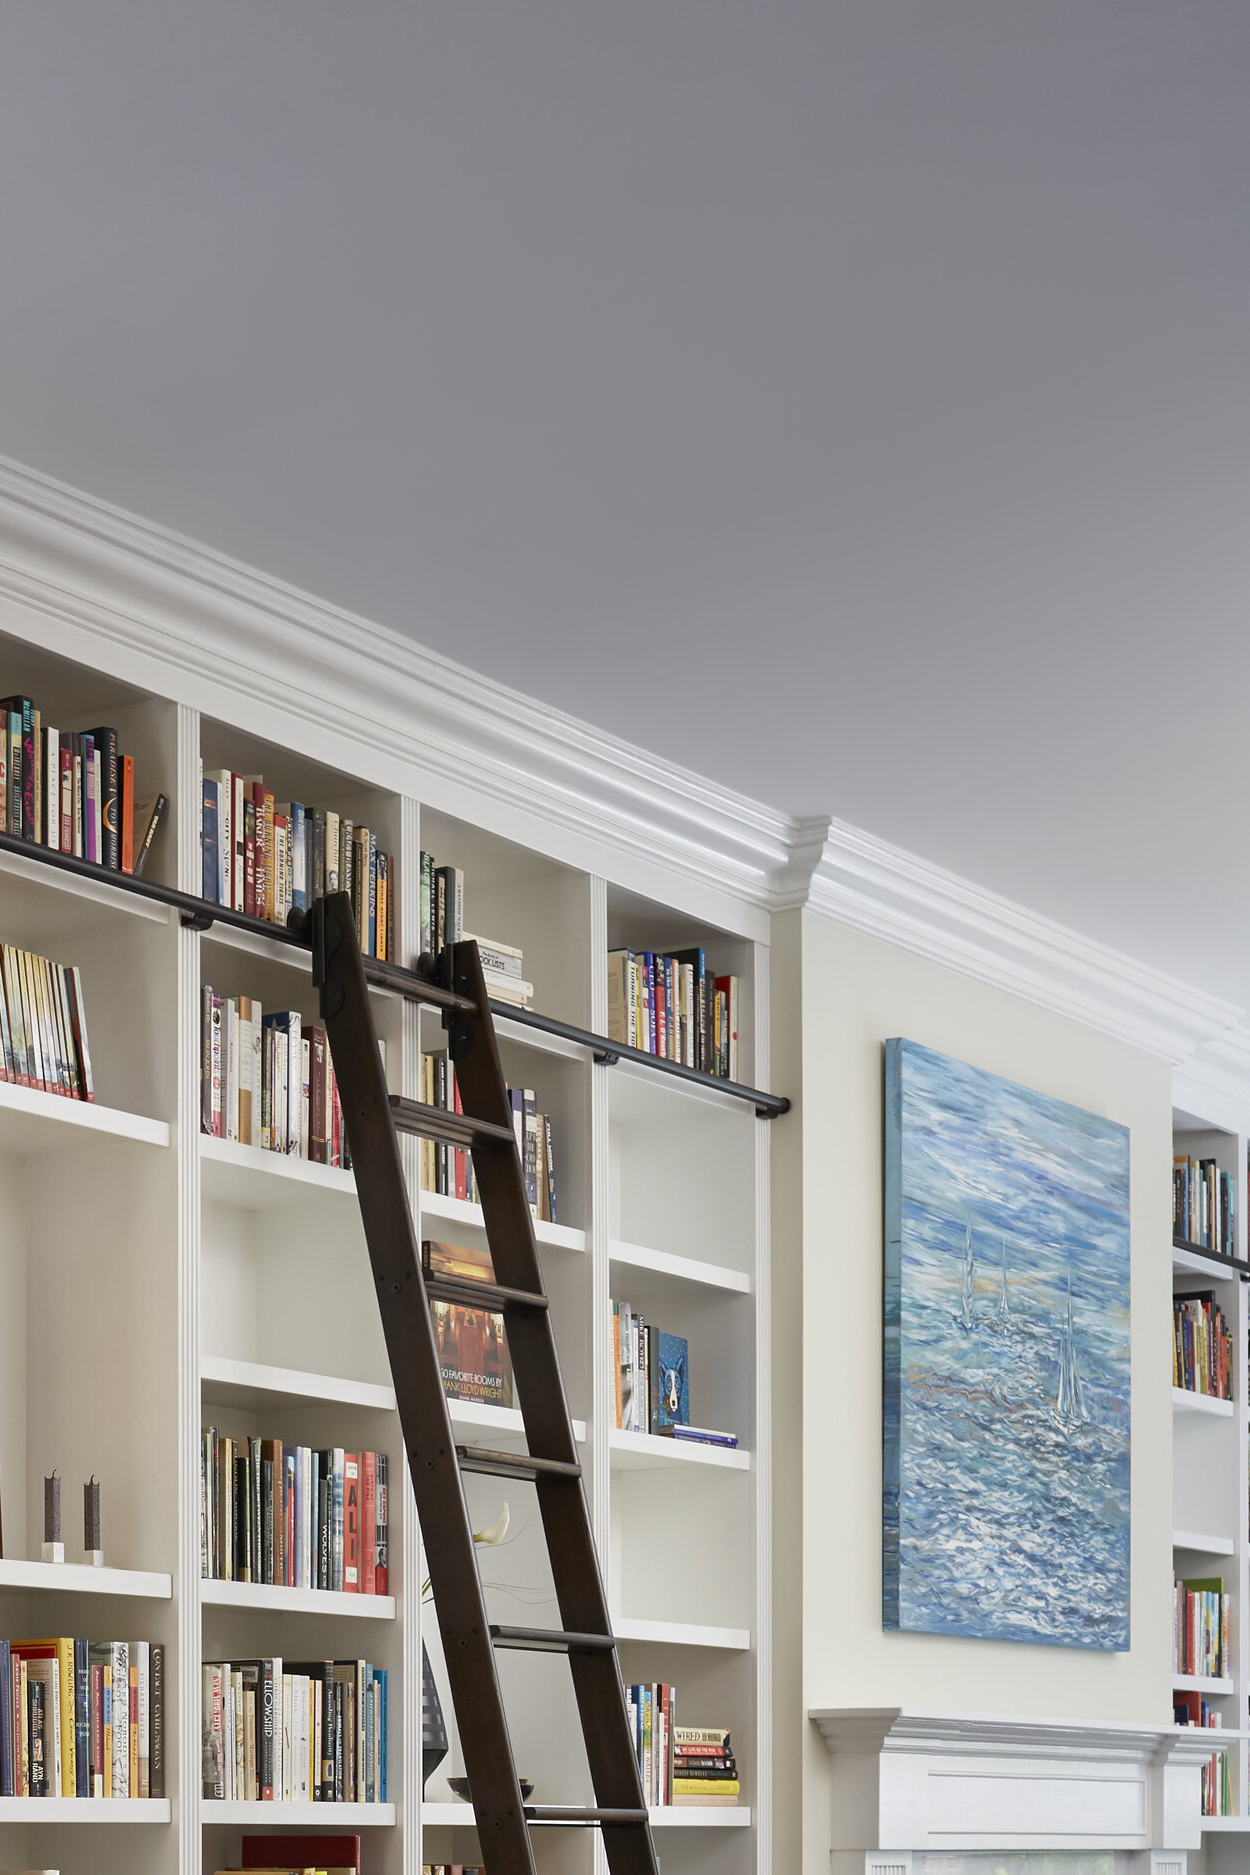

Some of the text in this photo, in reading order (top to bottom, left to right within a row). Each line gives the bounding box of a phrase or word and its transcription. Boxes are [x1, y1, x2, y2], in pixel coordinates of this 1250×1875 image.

[480, 957, 505, 970] OCK LISTS
[449, 1369, 474, 1382] FAVORITE
[474, 1374, 495, 1386] ROOMS
[495, 1377, 503, 1387] BY
[444, 1381, 502, 1399] RANK LLOYD WRIGHT
[153, 1649, 162, 1698] CONTACT
[213, 1676, 222, 1731] NEW YORK CITY
[676, 1731, 700, 1741] WIRED
